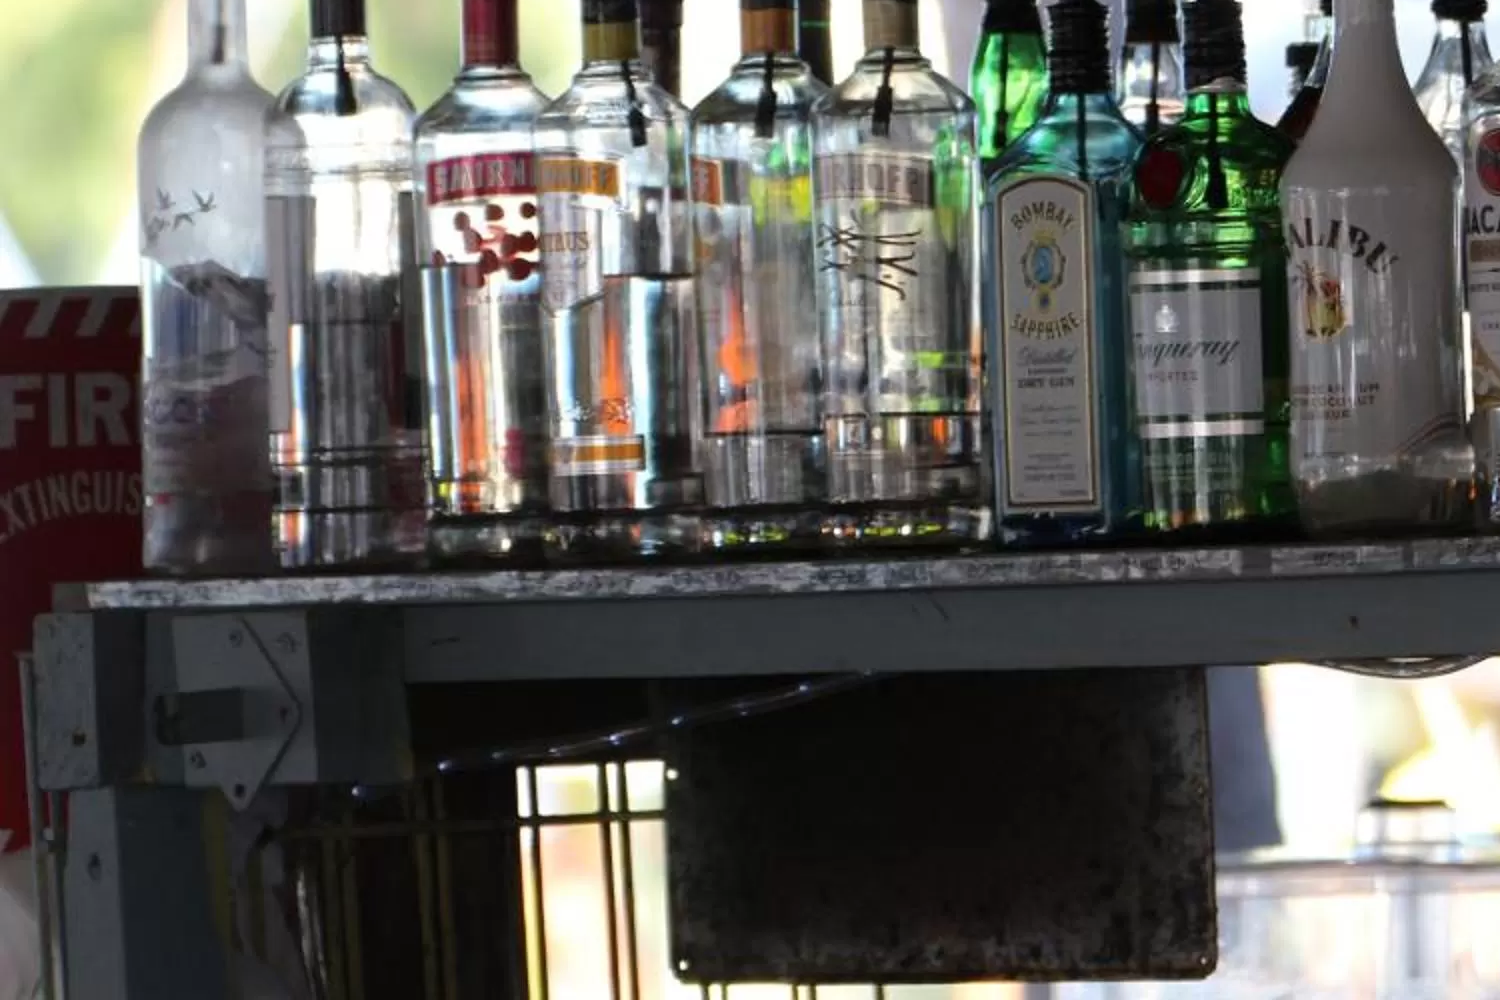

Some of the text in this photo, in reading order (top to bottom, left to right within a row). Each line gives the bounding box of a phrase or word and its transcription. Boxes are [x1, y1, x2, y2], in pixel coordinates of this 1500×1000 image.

[434, 160, 529, 192] SMIRN
[823, 160, 920, 198] IRNOFF
[1010, 200, 1076, 231] BOMBAY
[1284, 216, 1399, 275] ALIBU
[1011, 310, 1081, 341] SAPPHIRE
[1134, 332, 1241, 368] anqueray
[0, 370, 140, 449] FIR
[0, 469, 141, 546] XTINGUIS
